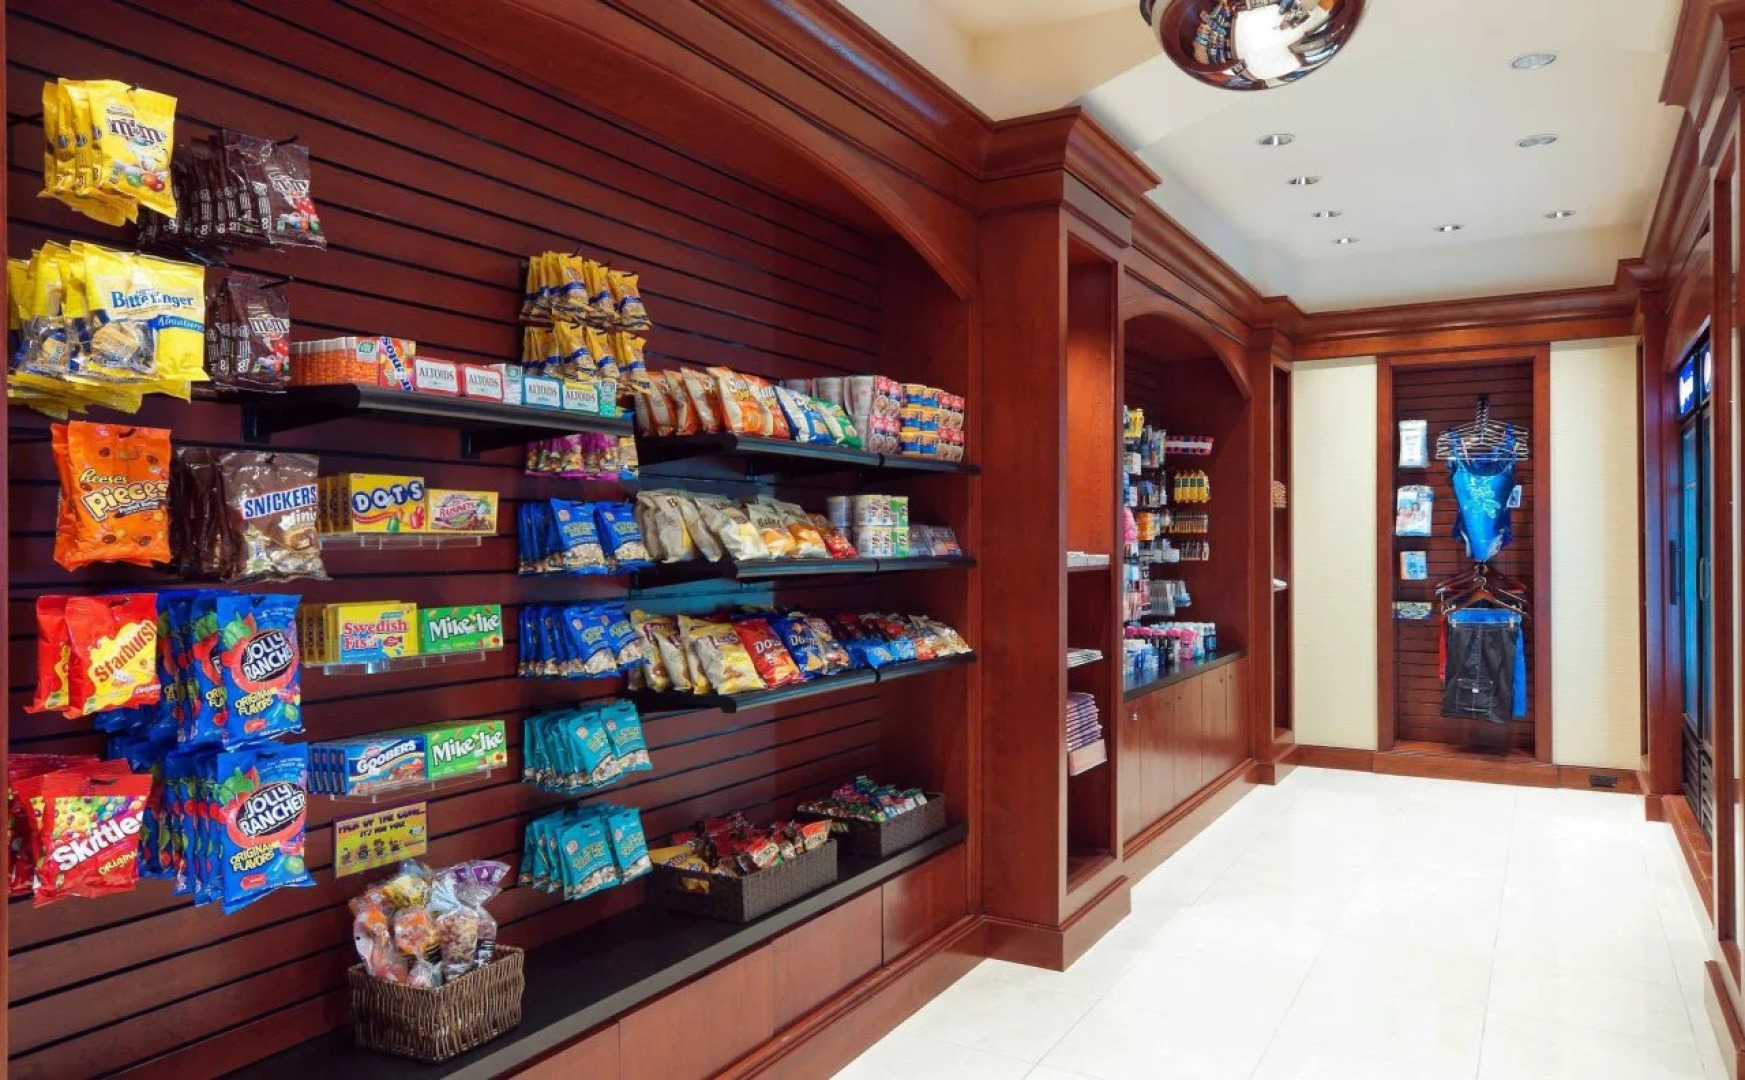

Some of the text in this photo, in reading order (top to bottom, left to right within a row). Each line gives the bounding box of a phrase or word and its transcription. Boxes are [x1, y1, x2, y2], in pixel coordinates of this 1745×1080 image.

[418, 366, 455, 382] ALTOIDS
[468, 374, 500, 388] ALTOIDS
[528, 384, 557, 397] ALTOIDS
[565, 389, 596, 402] ALTOIDS
[243, 486, 317, 518] SNICKERS
[352, 480, 424, 513] DOTS
[343, 620, 408, 634] Swedish
[430, 612, 501, 643] Mike Ike
[245, 632, 284, 664] JOLLY
[344, 637, 378, 649] Fis
[238, 697, 274, 716] FLAVORS
[356, 739, 417, 776] GOOBERS
[432, 731, 504, 766] Mike Ike
[245, 783, 294, 820] JOLLY
[233, 853, 276, 872] FLAVORS
